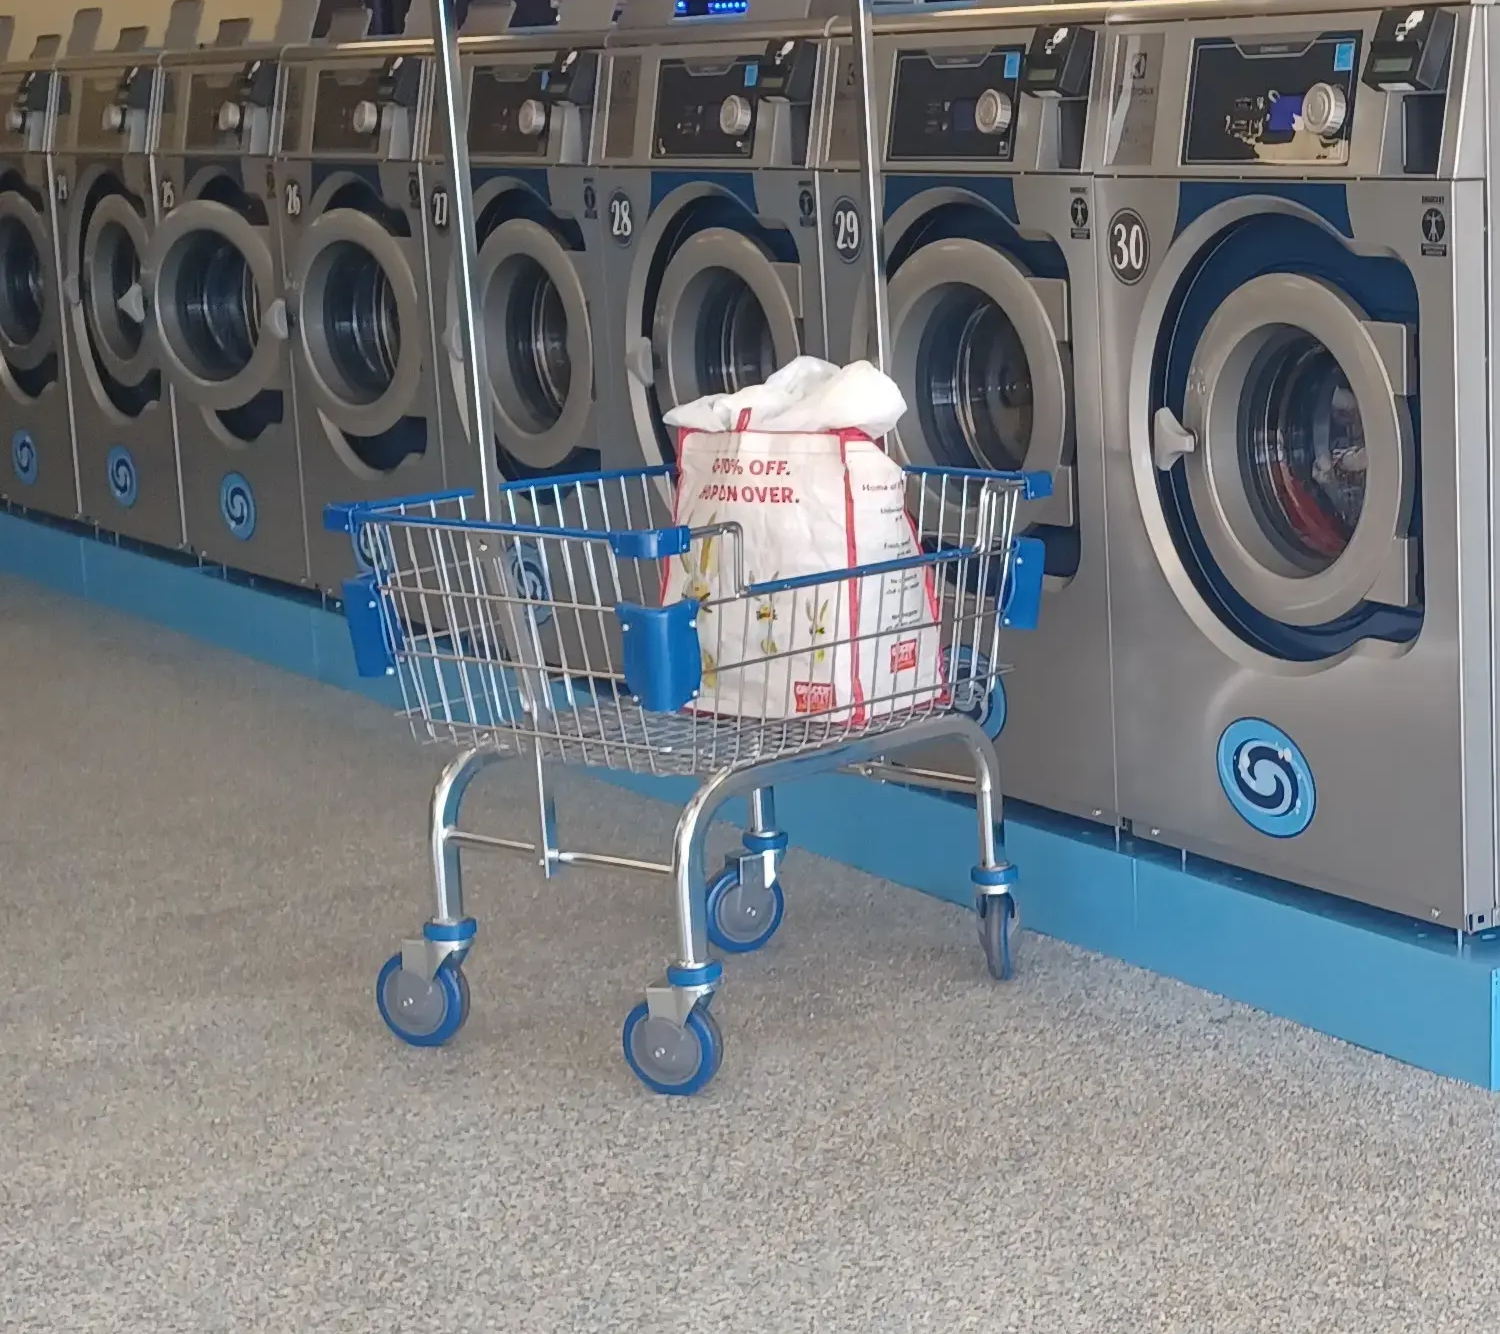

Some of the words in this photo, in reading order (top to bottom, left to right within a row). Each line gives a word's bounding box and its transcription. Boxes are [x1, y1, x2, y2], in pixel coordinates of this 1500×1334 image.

[286, 183, 301, 216] 26
[432, 192, 448, 226] 27
[611, 199, 632, 237] 28
[834, 209, 860, 250] 29
[1113, 223, 1144, 270] 30
[748, 459, 791, 476] OFF.
[741, 485, 800, 504] OVER.
